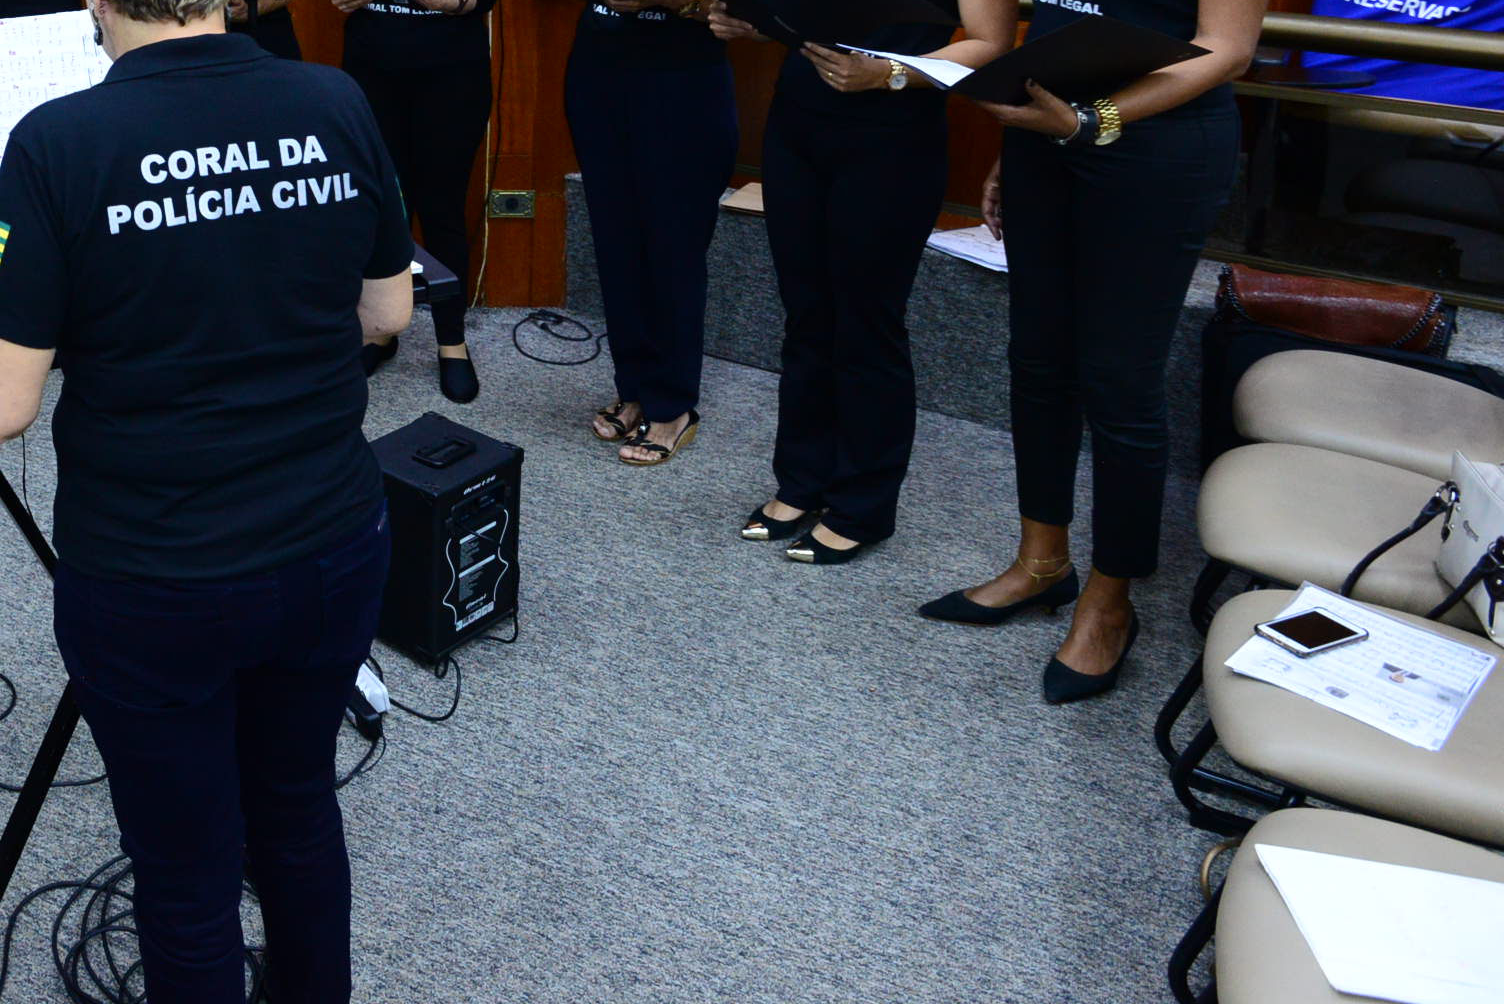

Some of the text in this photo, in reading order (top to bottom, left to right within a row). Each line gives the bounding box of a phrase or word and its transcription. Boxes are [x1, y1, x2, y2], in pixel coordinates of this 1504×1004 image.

[389, 4, 410, 14] TOM
[140, 135, 328, 185] CORAL DA
[106, 172, 359, 235] POLÍCIA CIVIL
